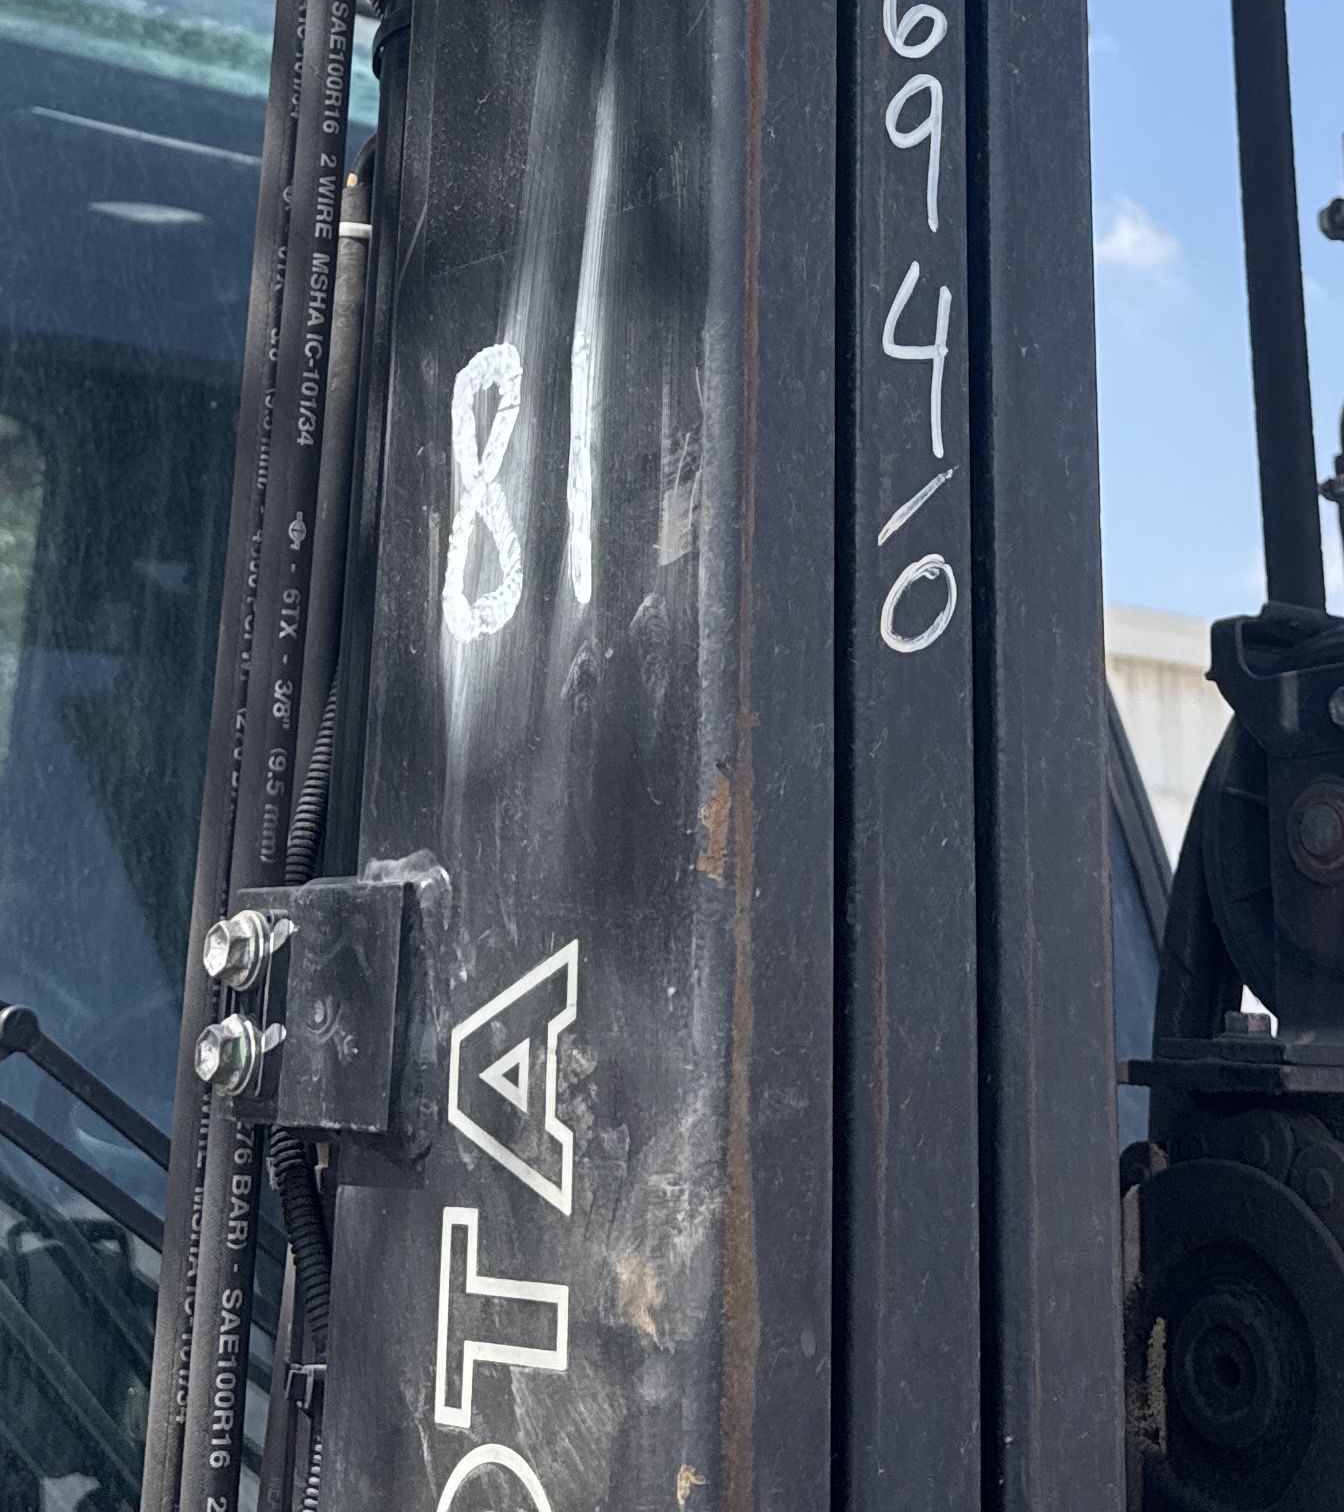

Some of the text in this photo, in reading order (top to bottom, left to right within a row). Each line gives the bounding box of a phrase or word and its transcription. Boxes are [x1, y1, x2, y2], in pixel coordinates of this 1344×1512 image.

[322, 0, 349, 135] SAE100R16
[319, 151, 338, 168] 2
[314, 175, 336, 240] WIRE
[306, 252, 330, 327] MSHA
[295, 332, 324, 447] IC-101/34
[279, 588, 301, 640] 6TX
[272, 678, 293, 731] 3/8"
[266, 747, 288, 797] (9.5
[227, 1174, 252, 1250] BAR)
[434, 938, 579, 1512] TA
[208, 1288, 243, 1469] SAE100R16
